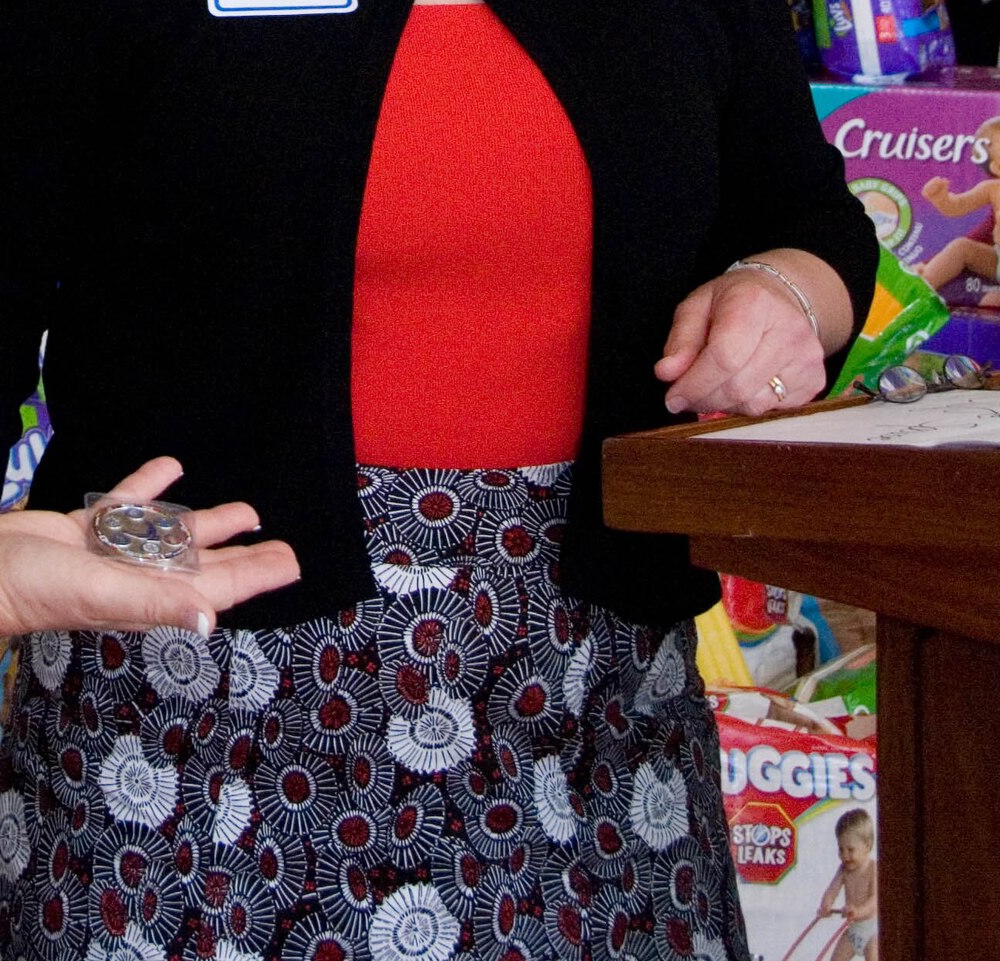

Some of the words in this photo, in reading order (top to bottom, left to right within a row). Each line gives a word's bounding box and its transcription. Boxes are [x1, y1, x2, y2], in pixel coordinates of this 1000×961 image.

[834, 117, 991, 164] Cruisers
[720, 745, 876, 800] UGGIES
[732, 823, 792, 847] STOPS
[737, 845, 787, 865] LEAKS
